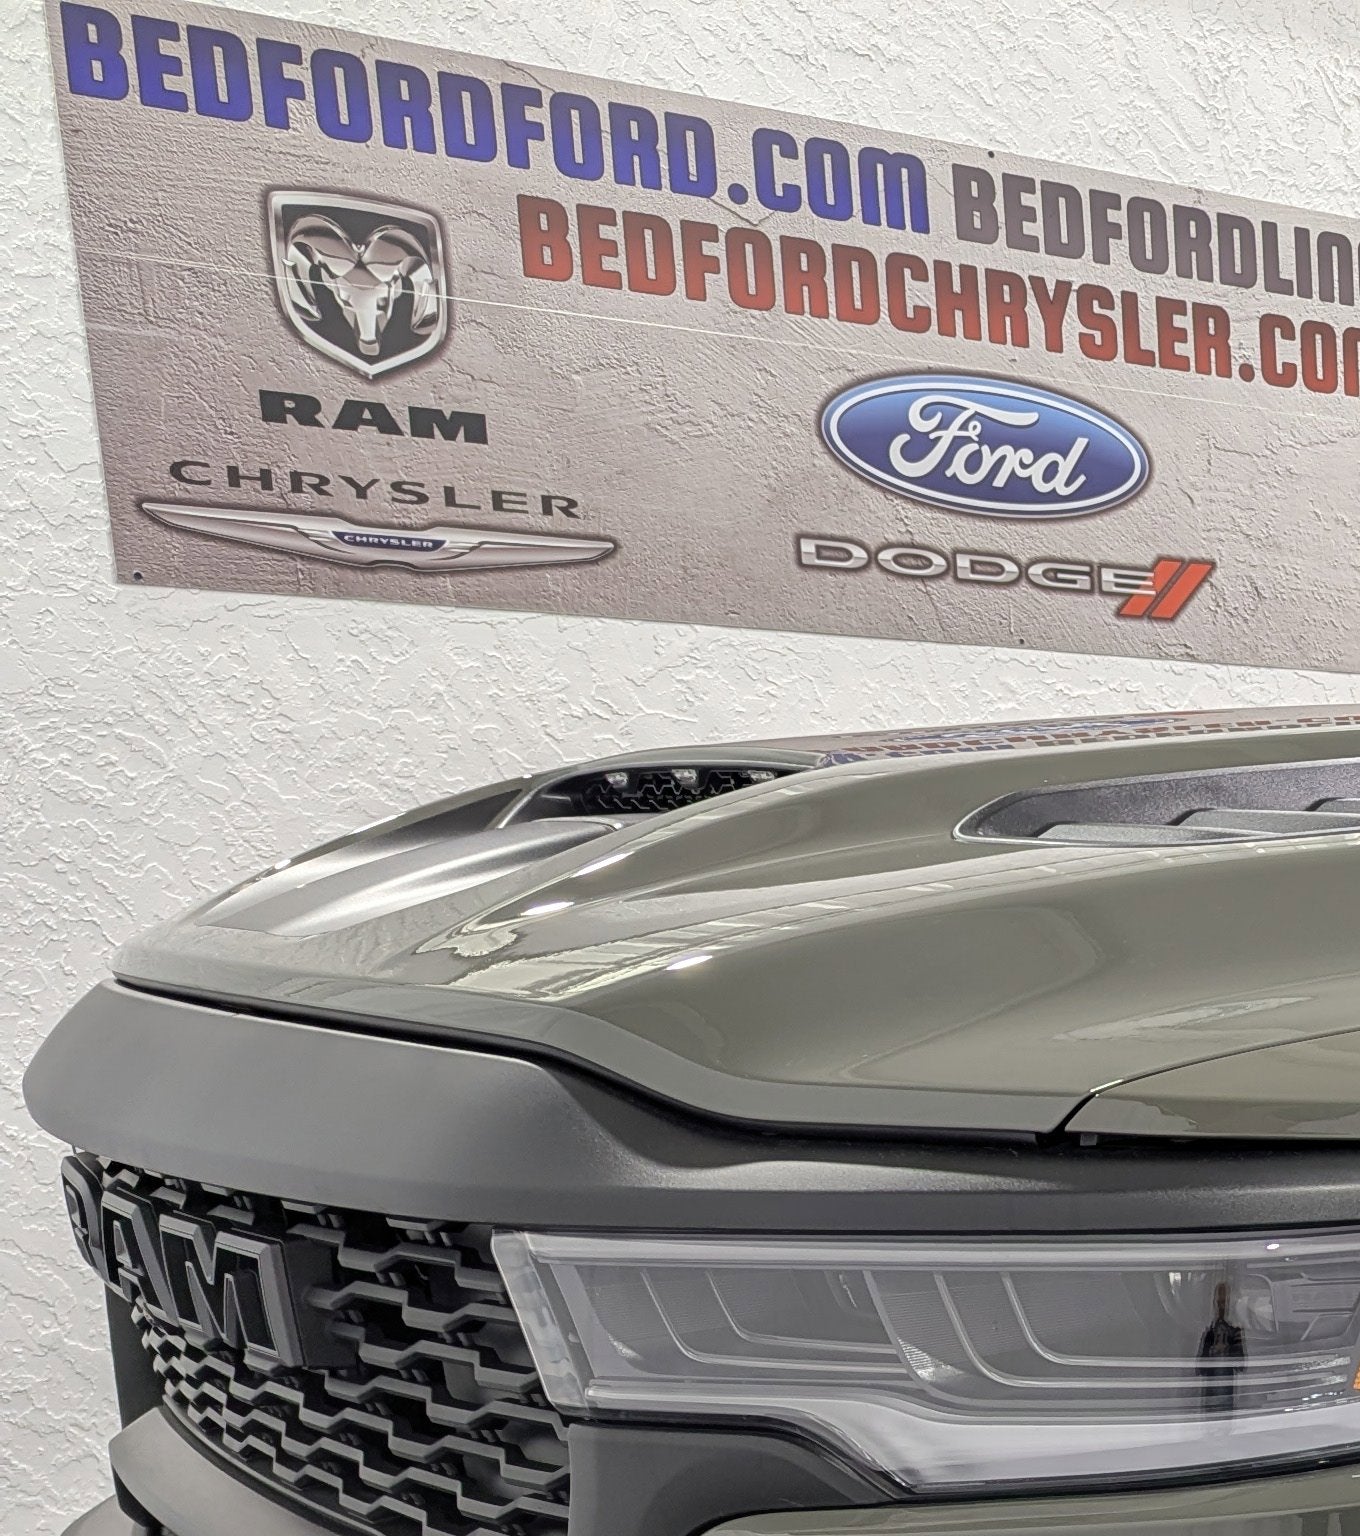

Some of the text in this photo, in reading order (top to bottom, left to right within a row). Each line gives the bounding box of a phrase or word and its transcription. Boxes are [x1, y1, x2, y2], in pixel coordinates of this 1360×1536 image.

[60, 1, 930, 235] BEDFORDFORD.COM
[259, 390, 489, 446] RAM
[890, 395, 1089, 498] Ford
[169, 460, 581, 521] CHRYSLER
[343, 535, 434, 549] CHRYSLER
[801, 538, 1158, 600] DODGE
[61, 1153, 305, 1370] RAM
